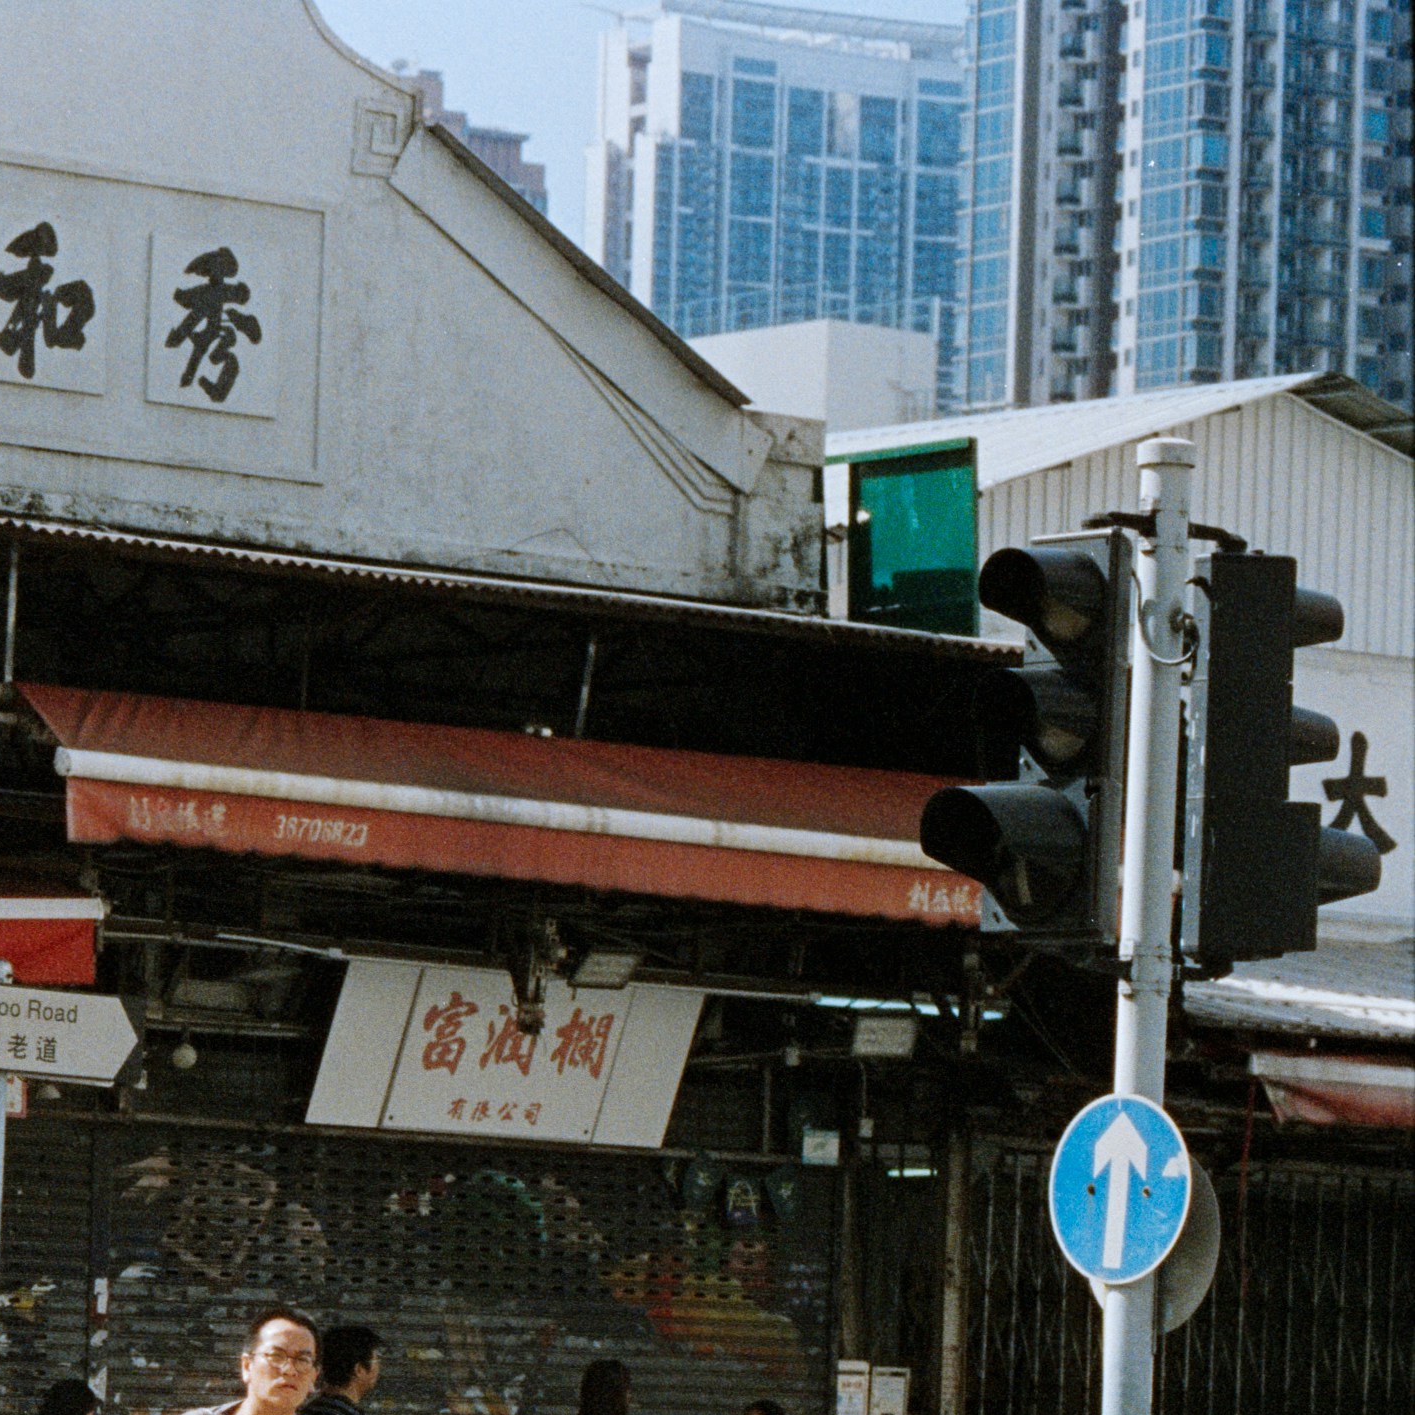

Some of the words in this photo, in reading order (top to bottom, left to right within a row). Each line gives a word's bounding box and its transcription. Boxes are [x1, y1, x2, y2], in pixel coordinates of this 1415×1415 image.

[1322, 731, 1396, 855] 大
[28, 1000, 78, 1023] Road
[448, 1098, 541, 1126] 有限公司
